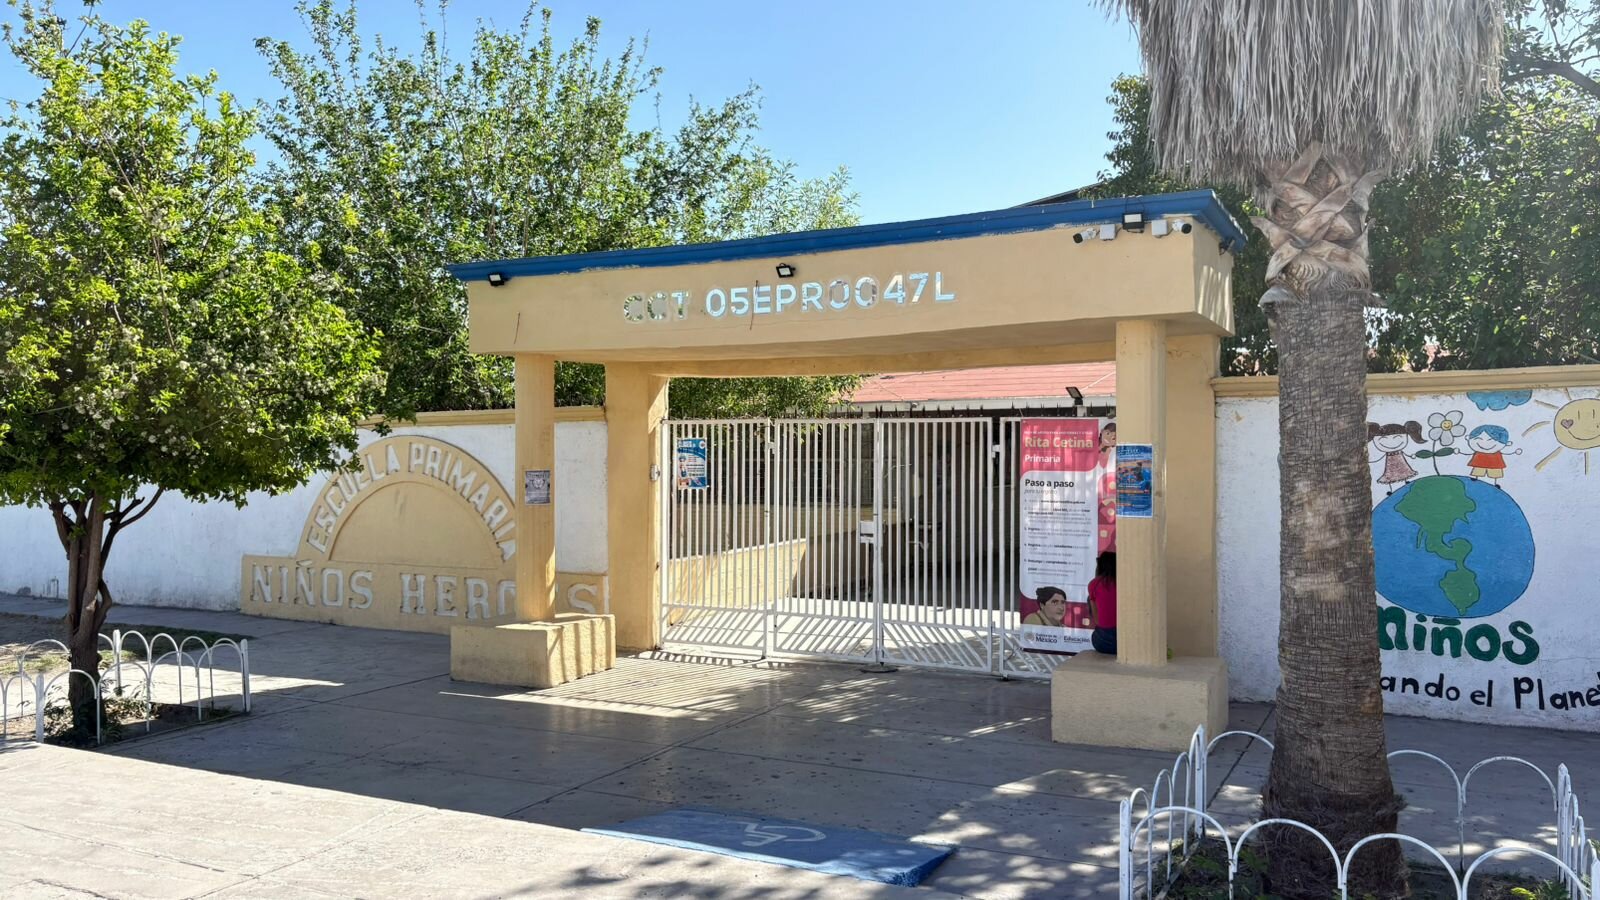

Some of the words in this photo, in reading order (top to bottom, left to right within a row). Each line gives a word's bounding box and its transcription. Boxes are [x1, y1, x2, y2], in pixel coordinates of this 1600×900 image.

[623, 290, 690, 322] CCT
[1024, 436, 1050, 448] Rita
[1053, 436, 1094, 448] Cetina
[1024, 454, 1061, 463] Primaria
[1025, 479, 1045, 487] Paso
[1053, 480, 1075, 489] paso
[307, 444, 401, 554] ESCUELA
[407, 442, 516, 563] PRIMARIA
[250, 559, 375, 610] NIÑOS
[399, 572, 599, 620] HEROS
[1380, 672, 1461, 702] ando
[1469, 679, 1494, 708] el
[1513, 671, 1600, 711] Plane
